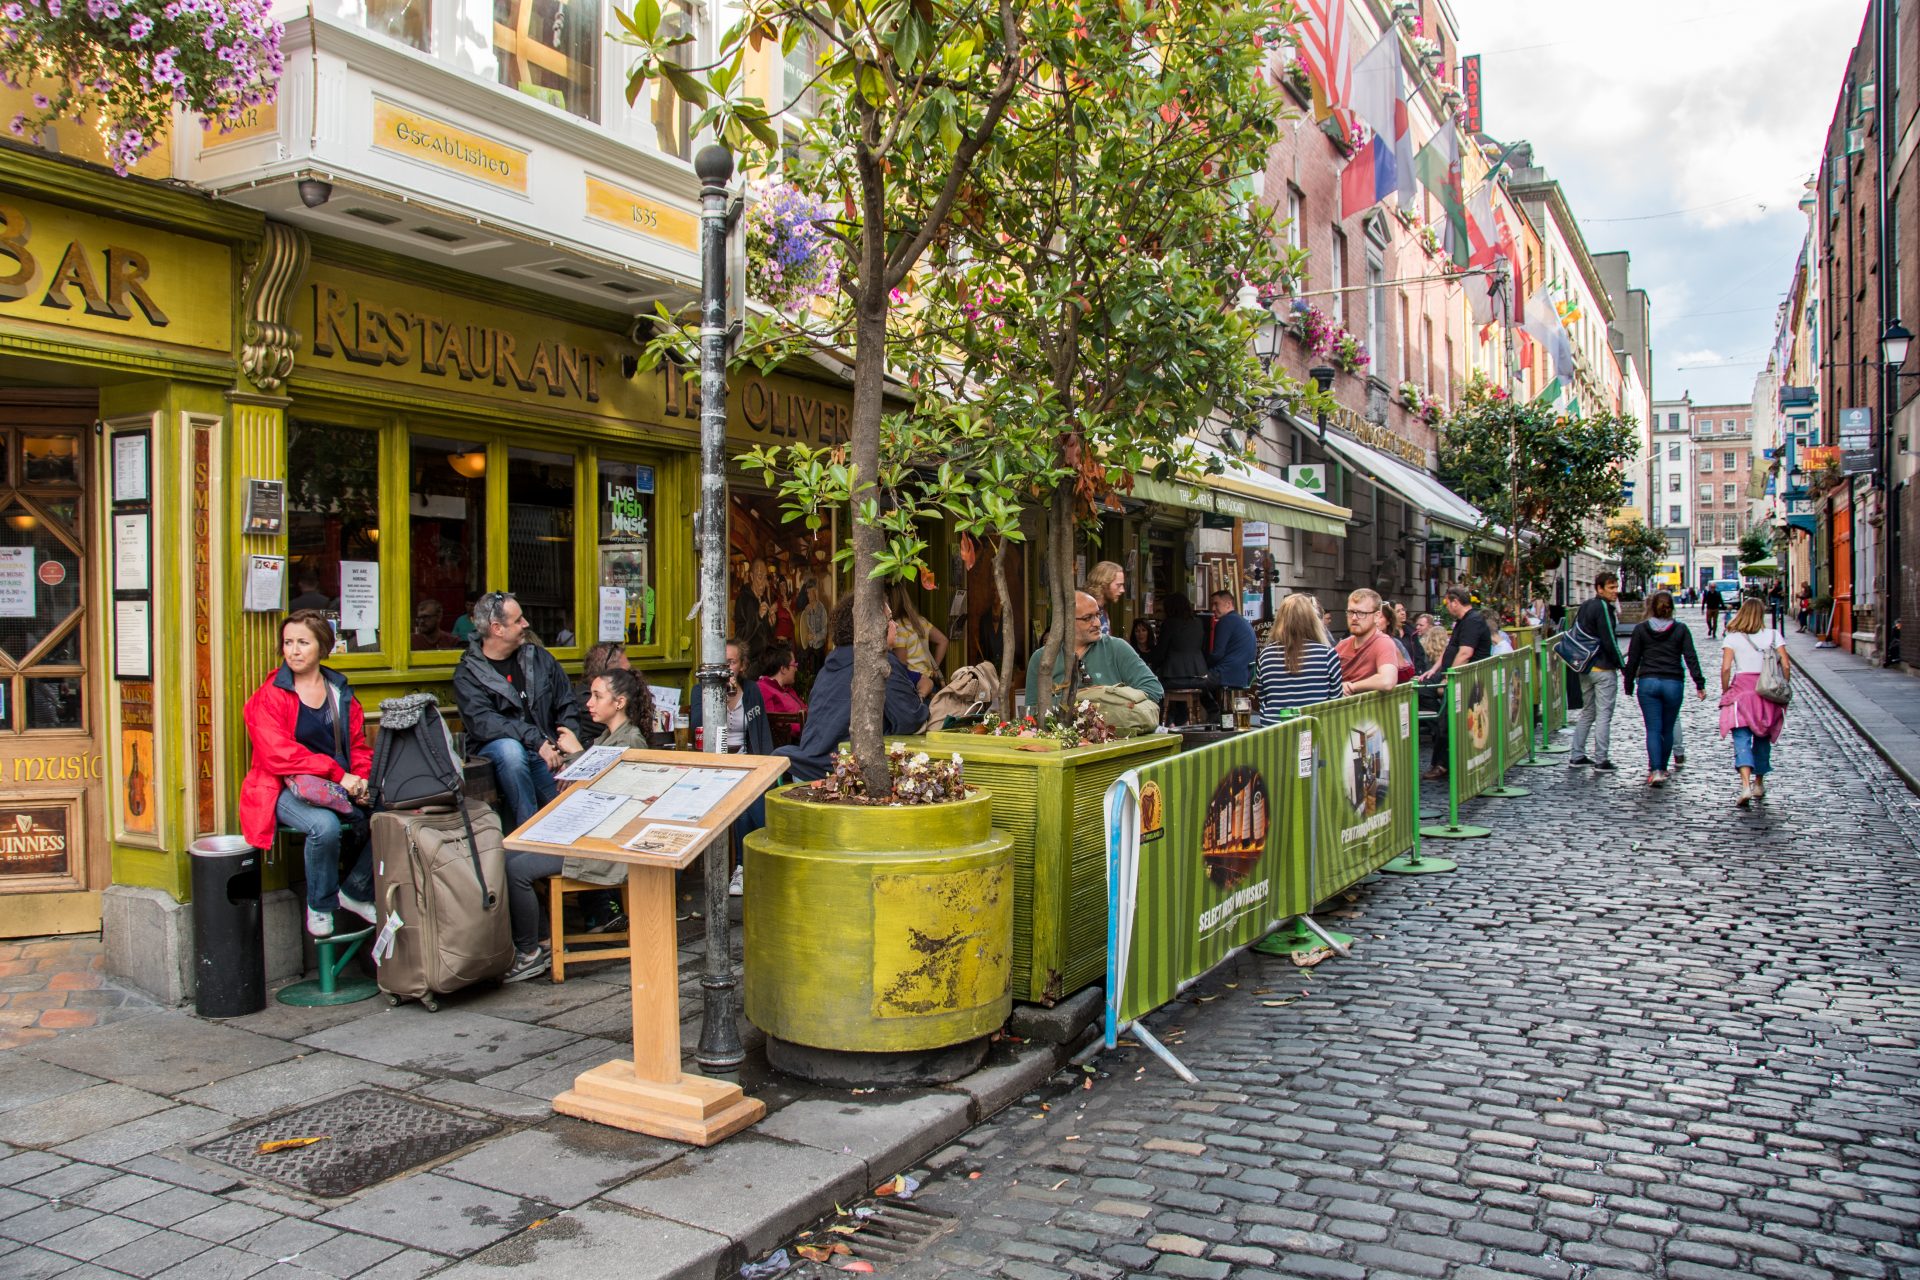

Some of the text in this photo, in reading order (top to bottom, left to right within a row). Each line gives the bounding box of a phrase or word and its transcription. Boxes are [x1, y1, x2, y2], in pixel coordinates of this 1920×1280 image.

[1467, 58, 1479, 131] HOSTEL
[632, 204, 656, 227] 1835
[311, 281, 605, 402] RESTAURANT
[742, 374, 851, 446] OLIVER
[608, 482, 635, 504] Live
[613, 498, 643, 519] Irish
[612, 512, 648, 536] Music
[194, 463, 213, 779] SMOKING AREA
[7, 853, 45, 861] DRAUGHT
[1199, 903, 1223, 933] SELECT
[1235, 878, 1269, 910] WHISKEYS
